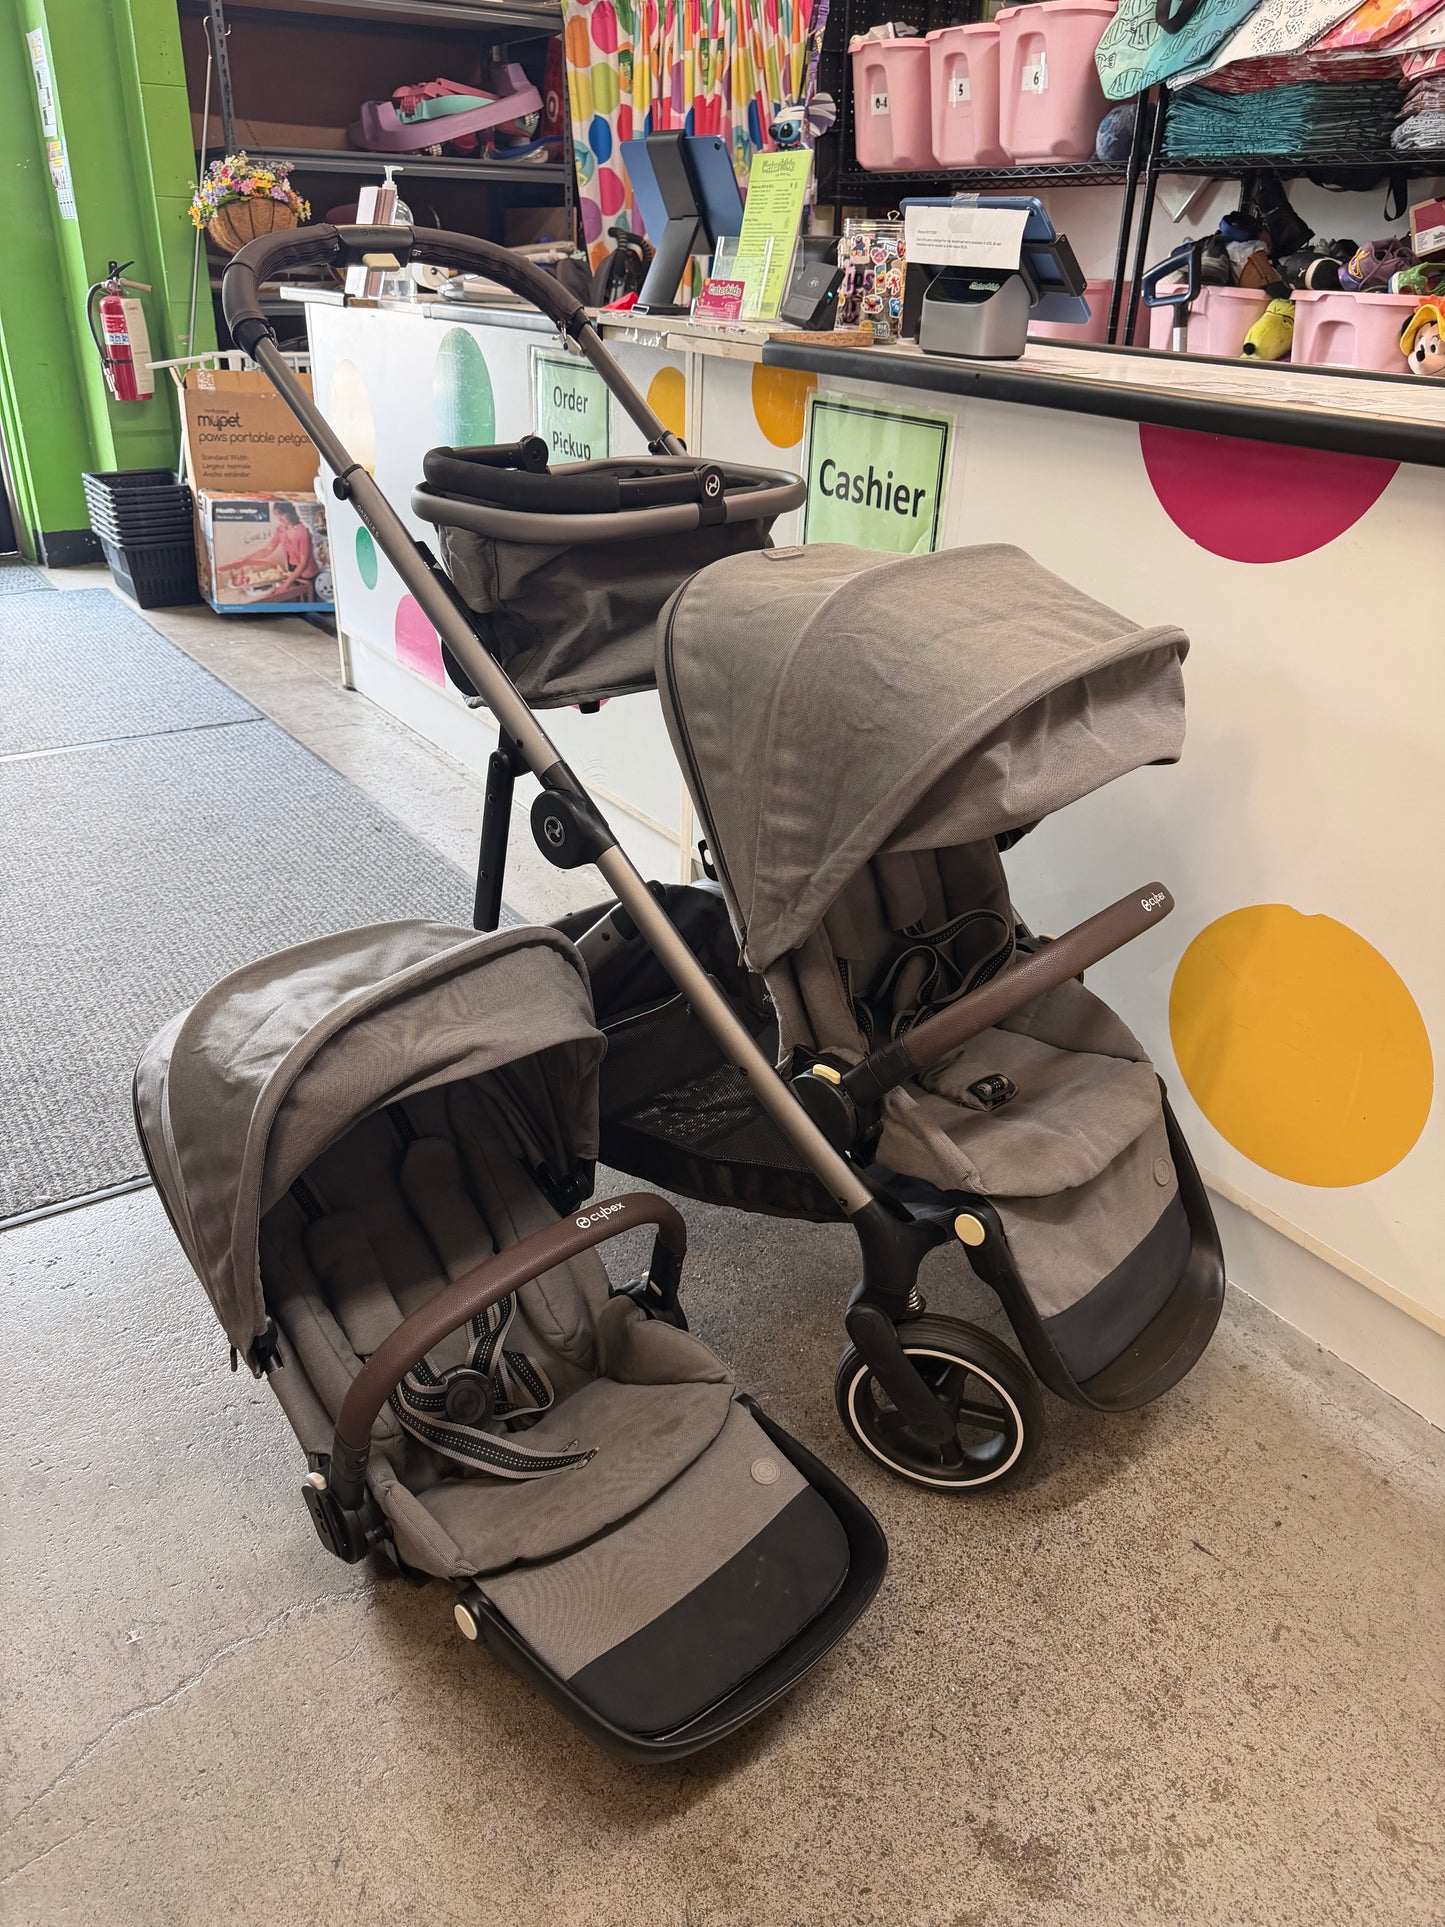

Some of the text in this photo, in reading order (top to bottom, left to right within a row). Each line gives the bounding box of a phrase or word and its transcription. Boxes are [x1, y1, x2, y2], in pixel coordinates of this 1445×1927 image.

[1033, 71, 1040, 85] 6
[958, 83, 964, 96] 5
[553, 385, 588, 414] Order
[199, 433, 227, 445] paws
[229, 432, 275, 446] portable
[552, 430, 591, 461] Pickup
[819, 458, 926, 518] Cashier
[590, 1202, 626, 1220] cybex
